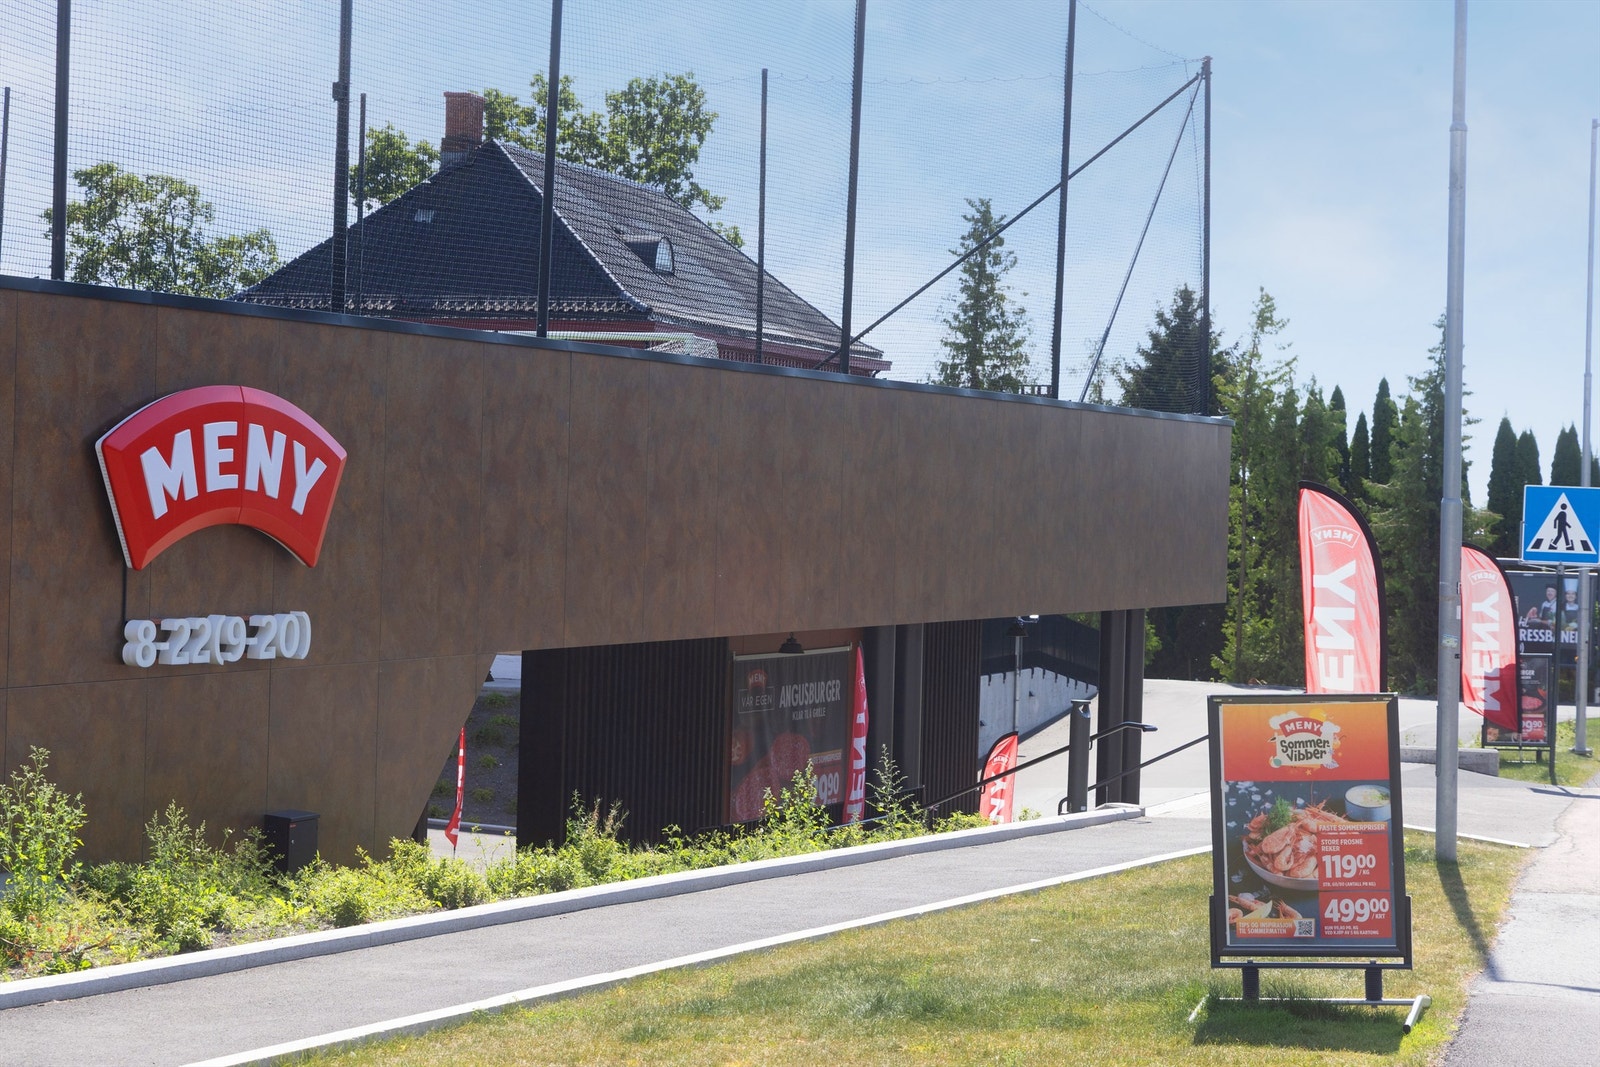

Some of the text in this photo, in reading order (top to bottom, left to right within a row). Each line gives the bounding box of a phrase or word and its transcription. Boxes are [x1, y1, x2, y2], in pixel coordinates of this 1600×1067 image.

[140, 421, 327, 520] MENY
[755, 694, 772, 706] EGEN
[779, 680, 841, 708] ANGUSBURGER
[1285, 721, 1321, 733] MENY
